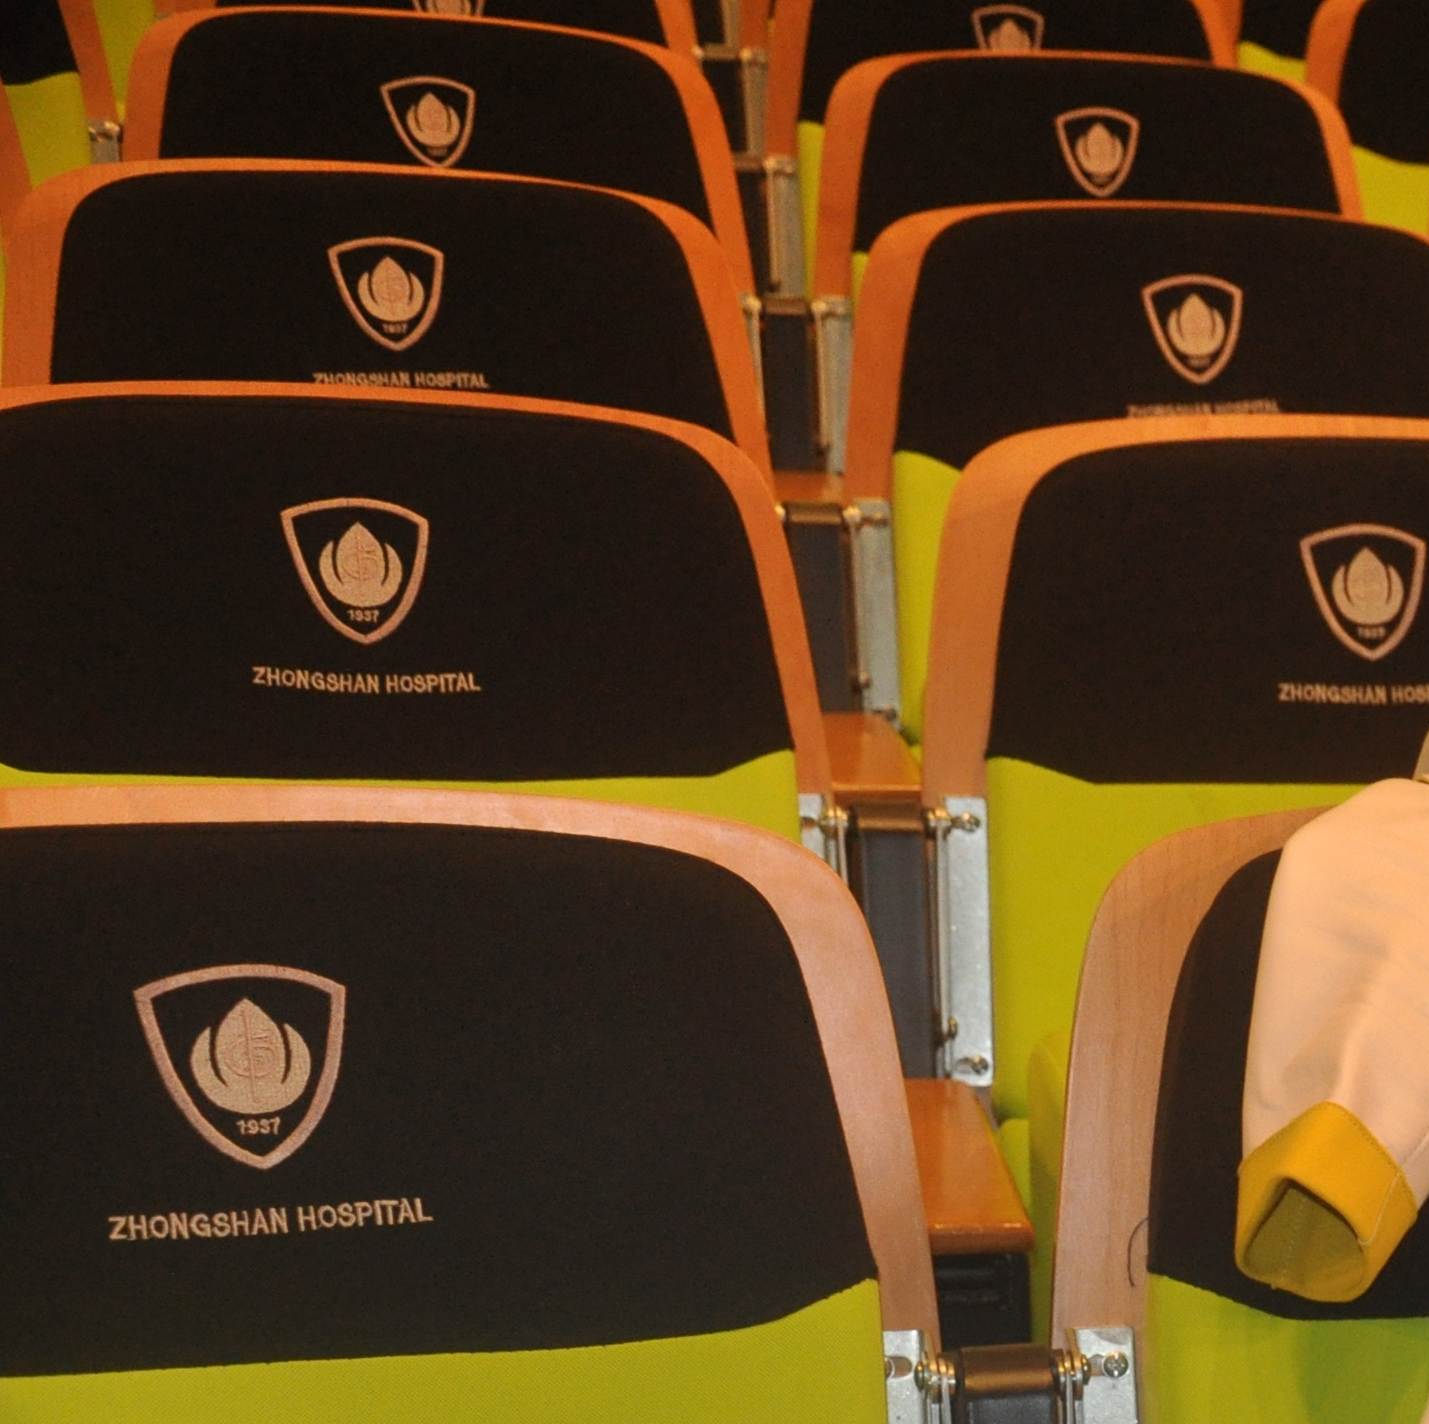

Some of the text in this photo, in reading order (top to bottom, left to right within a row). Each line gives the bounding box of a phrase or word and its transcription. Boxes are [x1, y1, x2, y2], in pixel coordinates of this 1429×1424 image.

[415, 372, 489, 389] HOSPITAL
[348, 609, 379, 623] 1937
[252, 666, 482, 694] ZHONGSHAN HOSPITAL
[1278, 682, 1388, 705] ZHONGSHAN
[236, 1116, 281, 1135] 1937
[108, 1197, 433, 1240] ZHONGSHAN HOSPITAL
